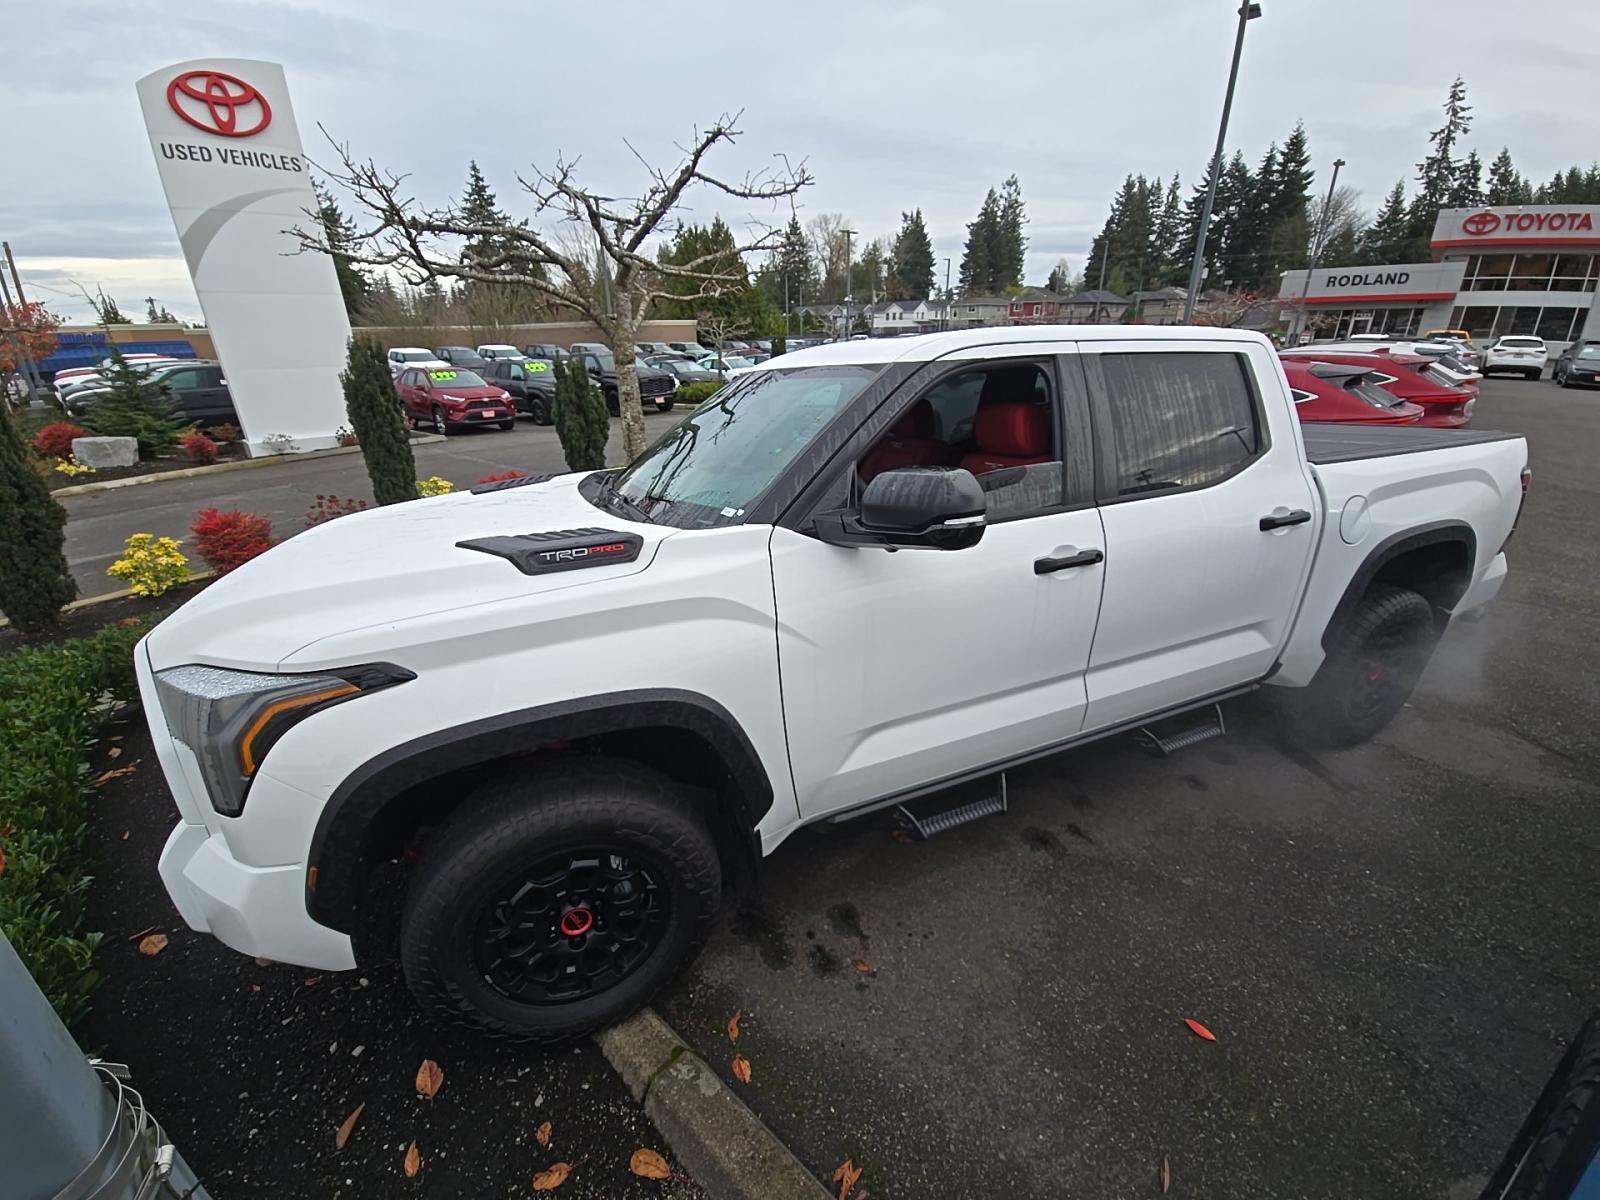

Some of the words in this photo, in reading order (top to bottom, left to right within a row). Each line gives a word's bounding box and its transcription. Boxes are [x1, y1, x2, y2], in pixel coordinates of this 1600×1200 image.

[160, 143, 212, 162] USED
[216, 148, 302, 172] VEHICLES
[1504, 213, 1593, 231] TOYOTA
[1326, 272, 1410, 288] RODLAND
